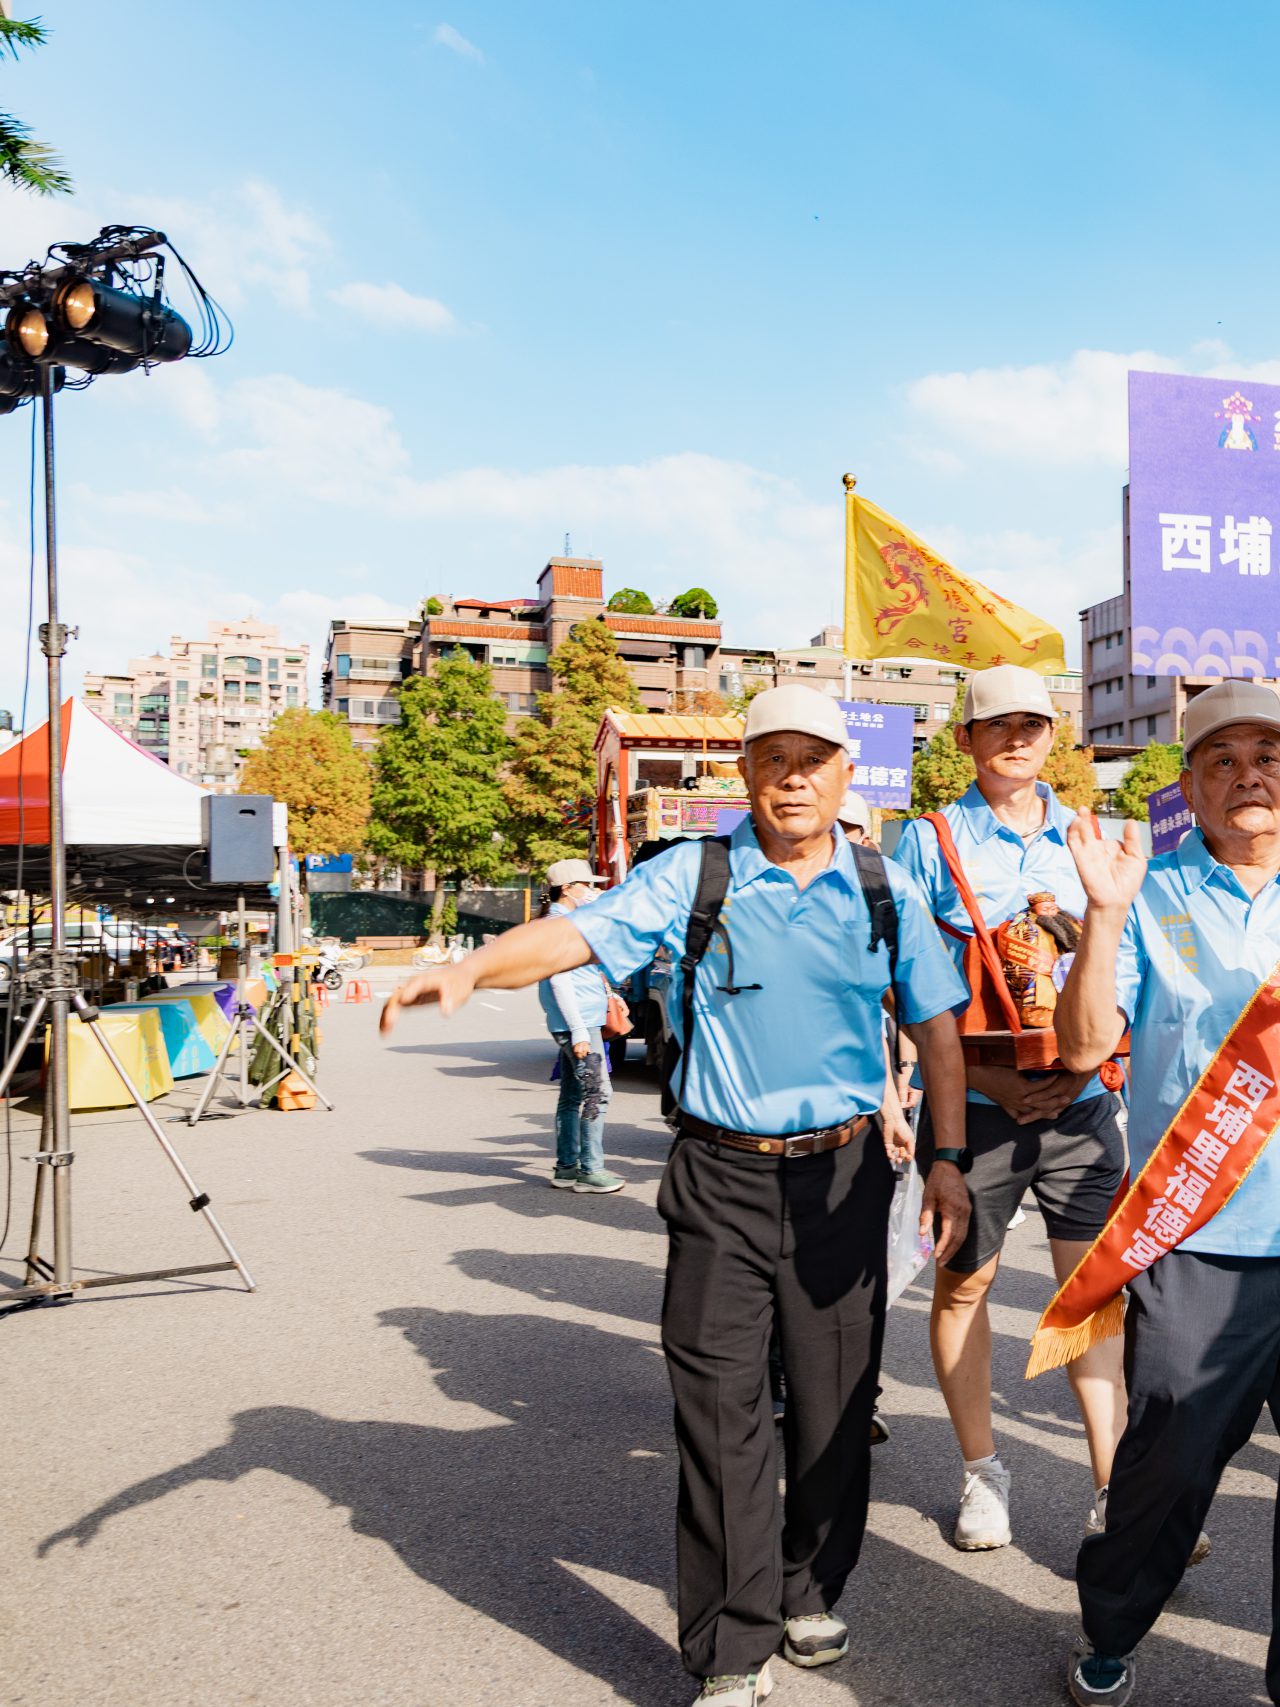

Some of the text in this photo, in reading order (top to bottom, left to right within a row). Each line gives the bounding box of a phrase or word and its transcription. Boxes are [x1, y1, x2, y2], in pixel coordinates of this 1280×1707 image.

[1120, 1059, 1275, 1271] 西埔里福德宮
